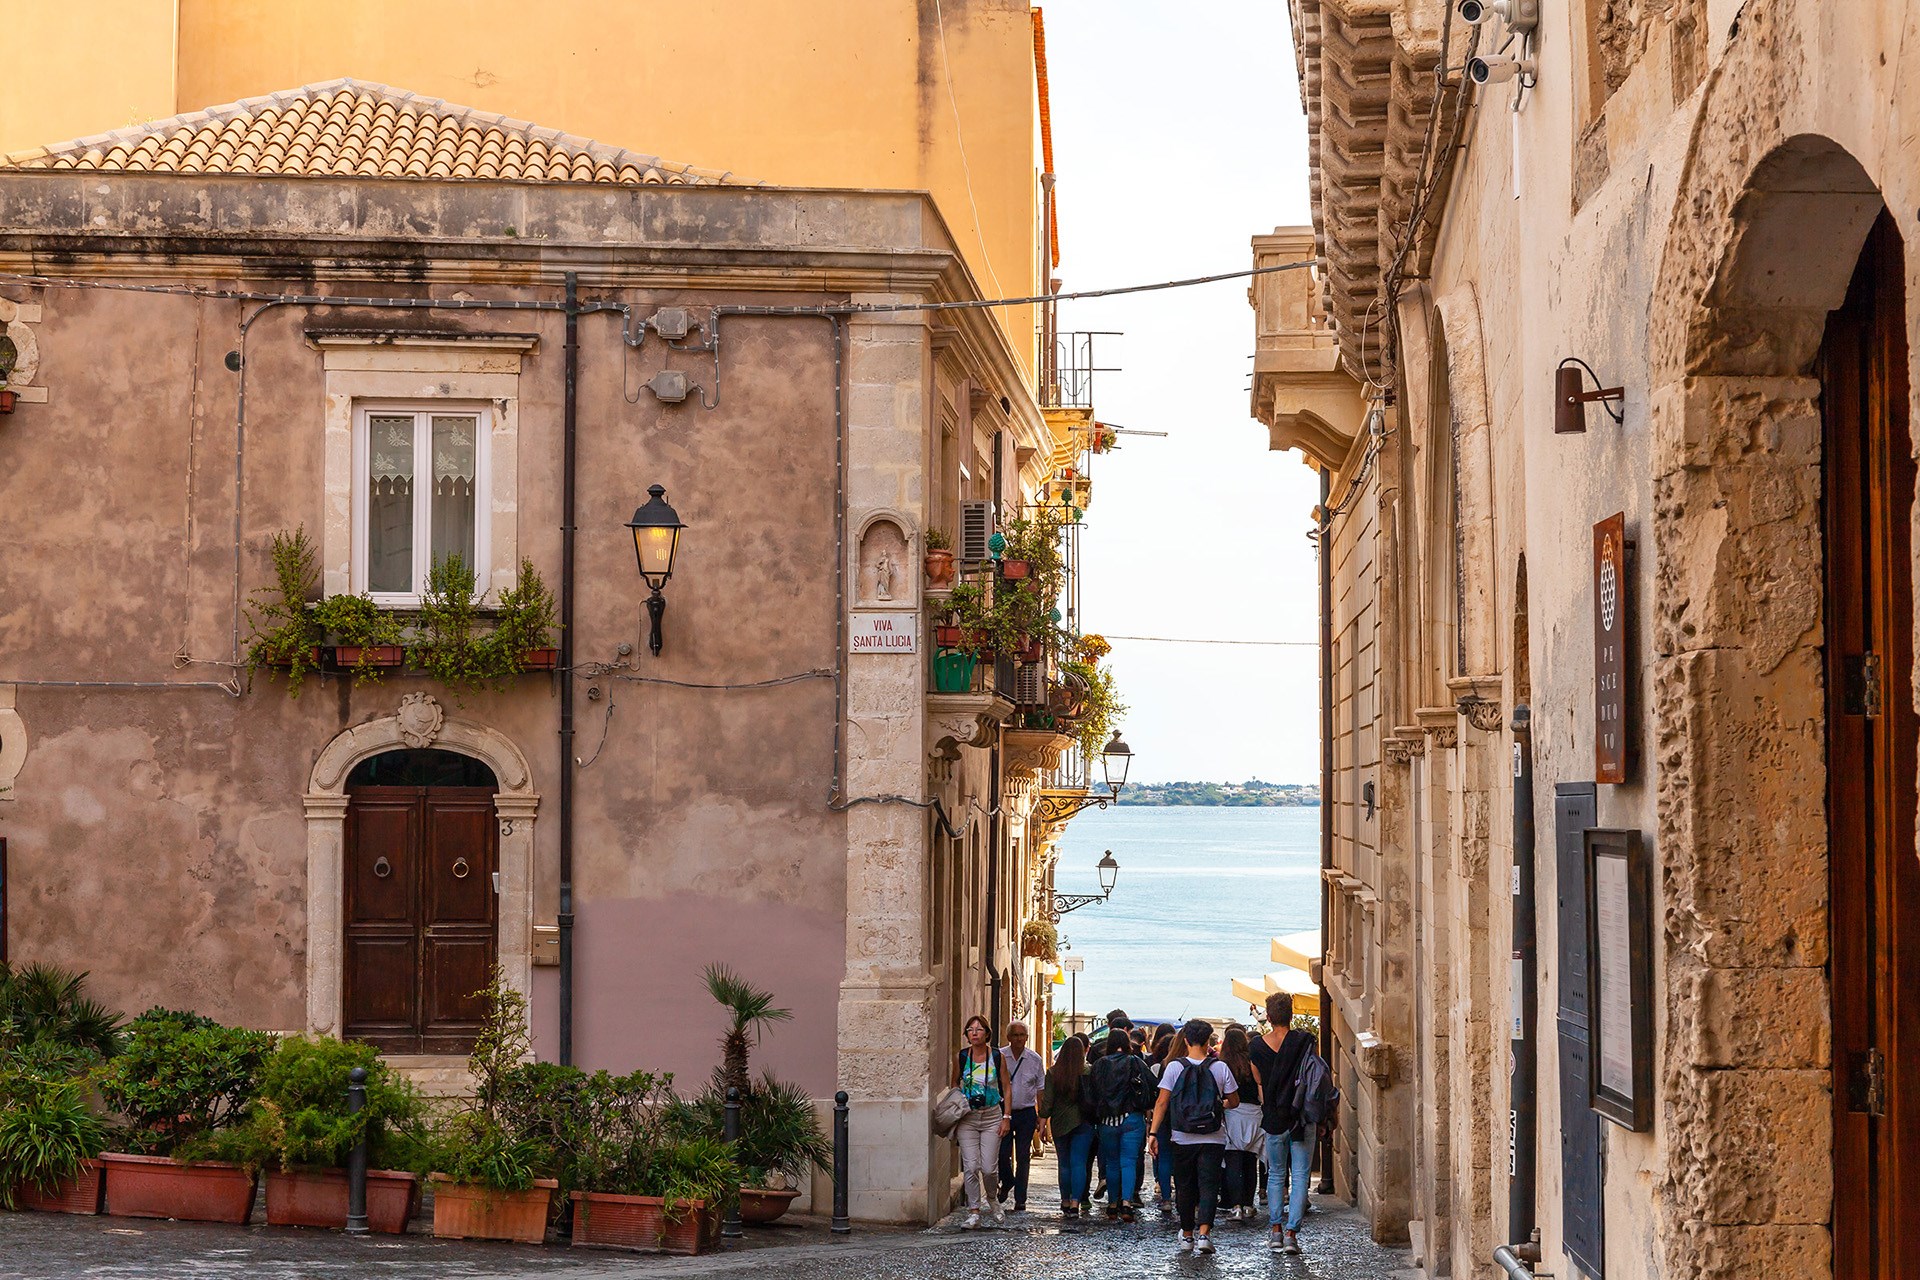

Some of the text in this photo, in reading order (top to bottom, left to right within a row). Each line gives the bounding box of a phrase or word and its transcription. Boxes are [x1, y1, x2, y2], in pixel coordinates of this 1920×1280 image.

[873, 620, 893, 631] VIVA
[853, 635, 912, 647] SANTA LUCIA
[501, 819, 514, 836] 3
